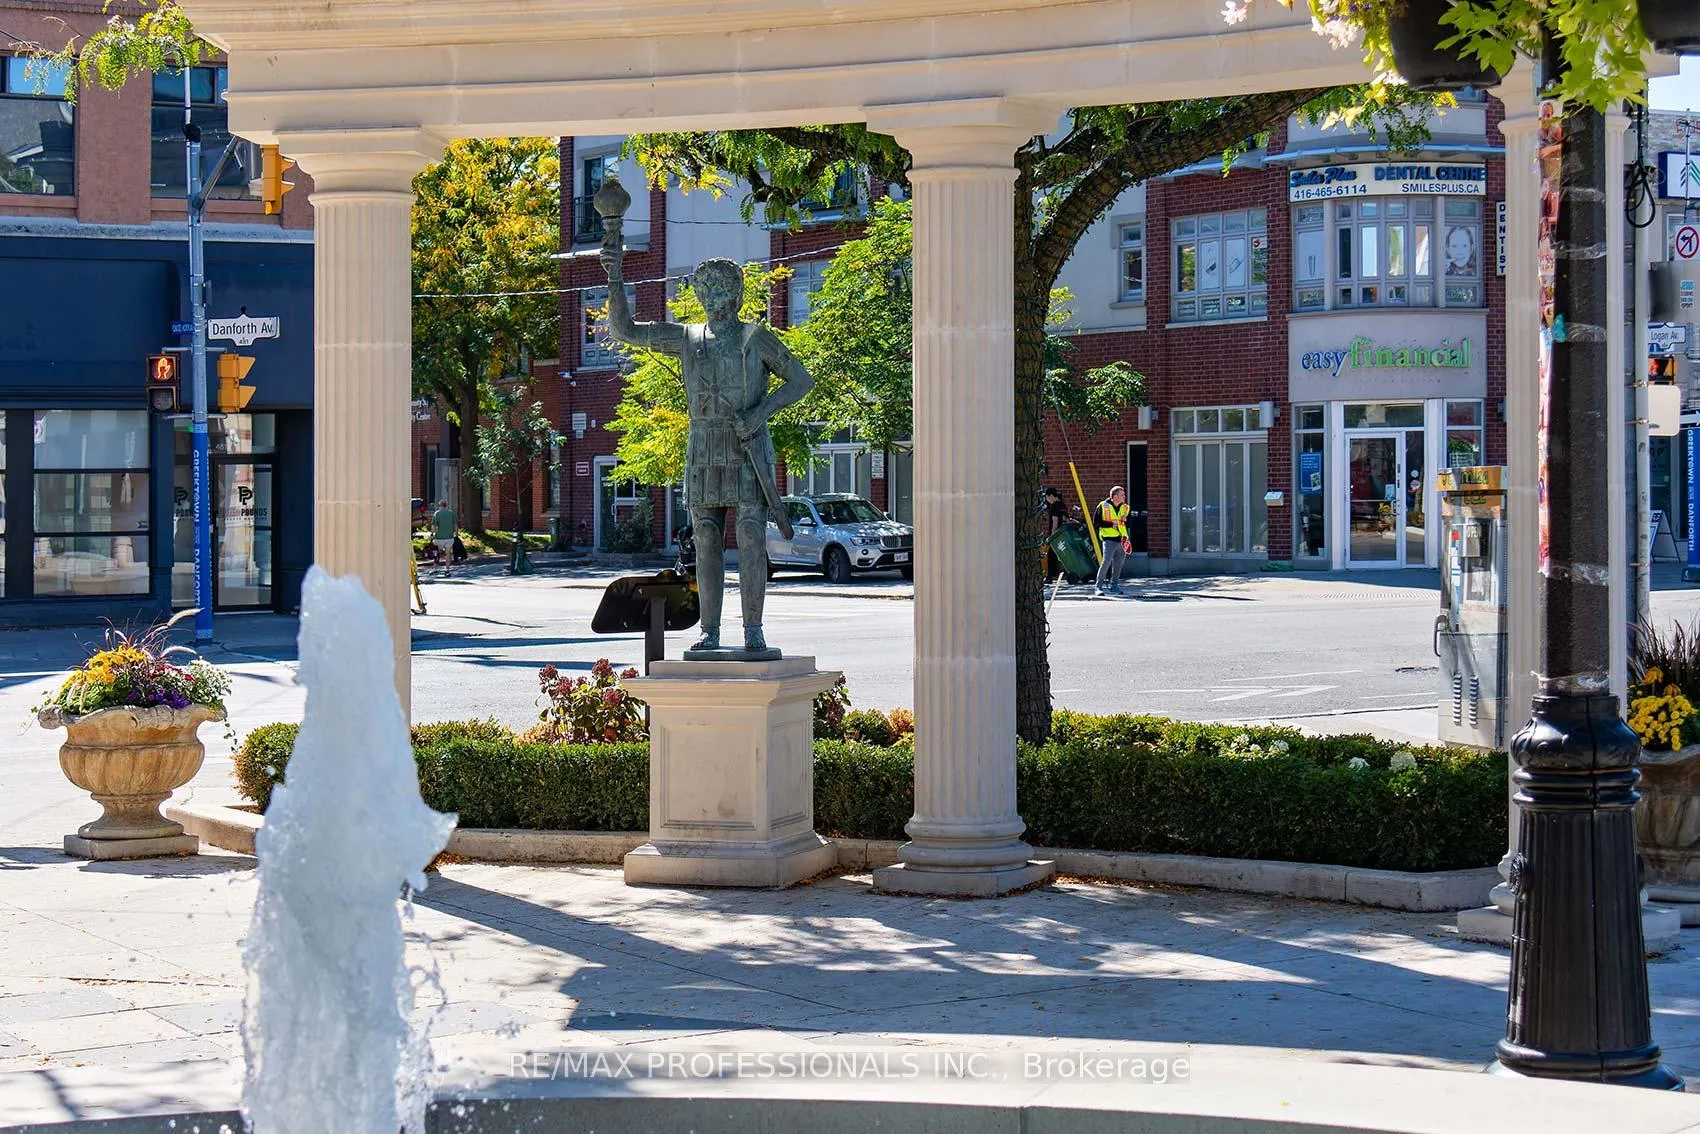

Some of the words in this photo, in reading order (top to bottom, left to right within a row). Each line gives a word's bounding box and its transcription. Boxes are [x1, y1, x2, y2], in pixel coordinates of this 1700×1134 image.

[1374, 166, 1435, 181] DENTAL
[1436, 166, 1486, 181] CENTRE
[1294, 184, 1367, 200] 416-465-6114
[1401, 183, 1480, 194] SMILESPLUS.CA
[1498, 203, 1506, 274] DENTIST
[212, 322, 257, 335] Danforth
[261, 322, 274, 334] Av.
[1650, 331, 1669, 342] Logan
[1687, 429, 1695, 484] GREEKTOWN
[193, 449, 201, 522] GREEKTOWN
[241, 508, 268, 517] POUNDS
[1687, 503, 1695, 551] DANFORTH
